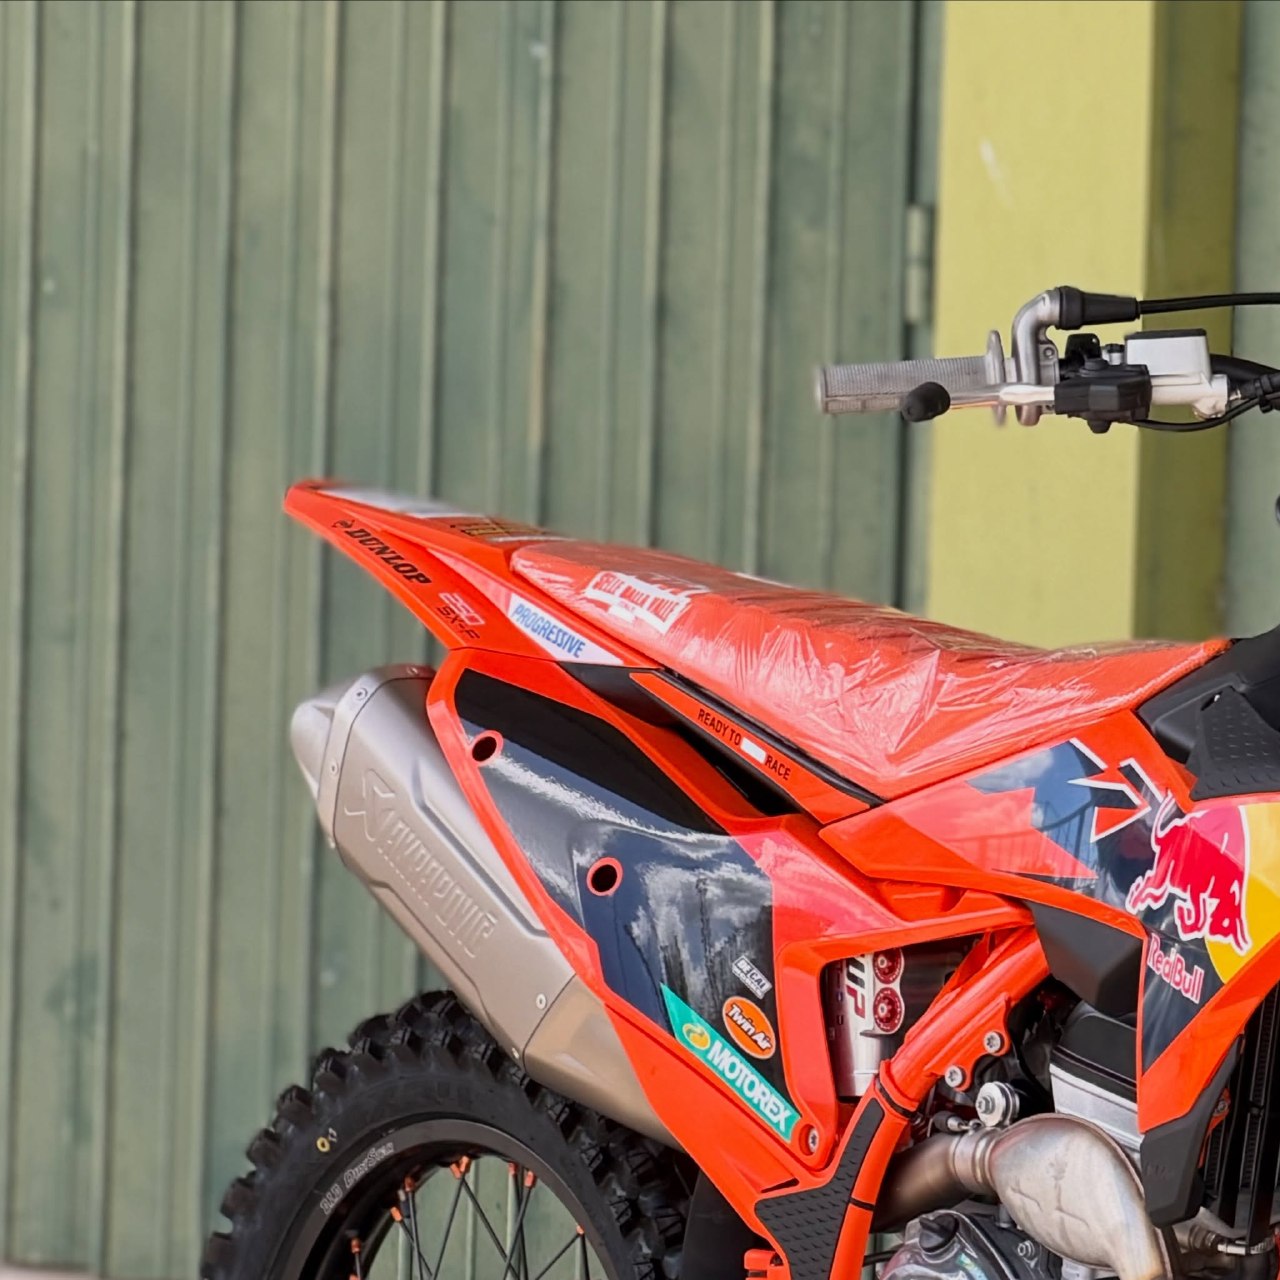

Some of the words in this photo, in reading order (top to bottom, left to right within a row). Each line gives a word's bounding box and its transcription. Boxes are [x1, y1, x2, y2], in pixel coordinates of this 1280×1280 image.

[347, 528, 432, 585] DUNLOP
[439, 592, 485, 626] 250
[511, 604, 586, 658] PROGRESSIVE
[698, 709, 729, 737] READY
[729, 729, 742, 746] TO
[764, 754, 791, 781] RACE
[727, 1004, 756, 1037] Twin
[752, 1031, 772, 1050] Air
[707, 1040, 792, 1133] MOTOREX
